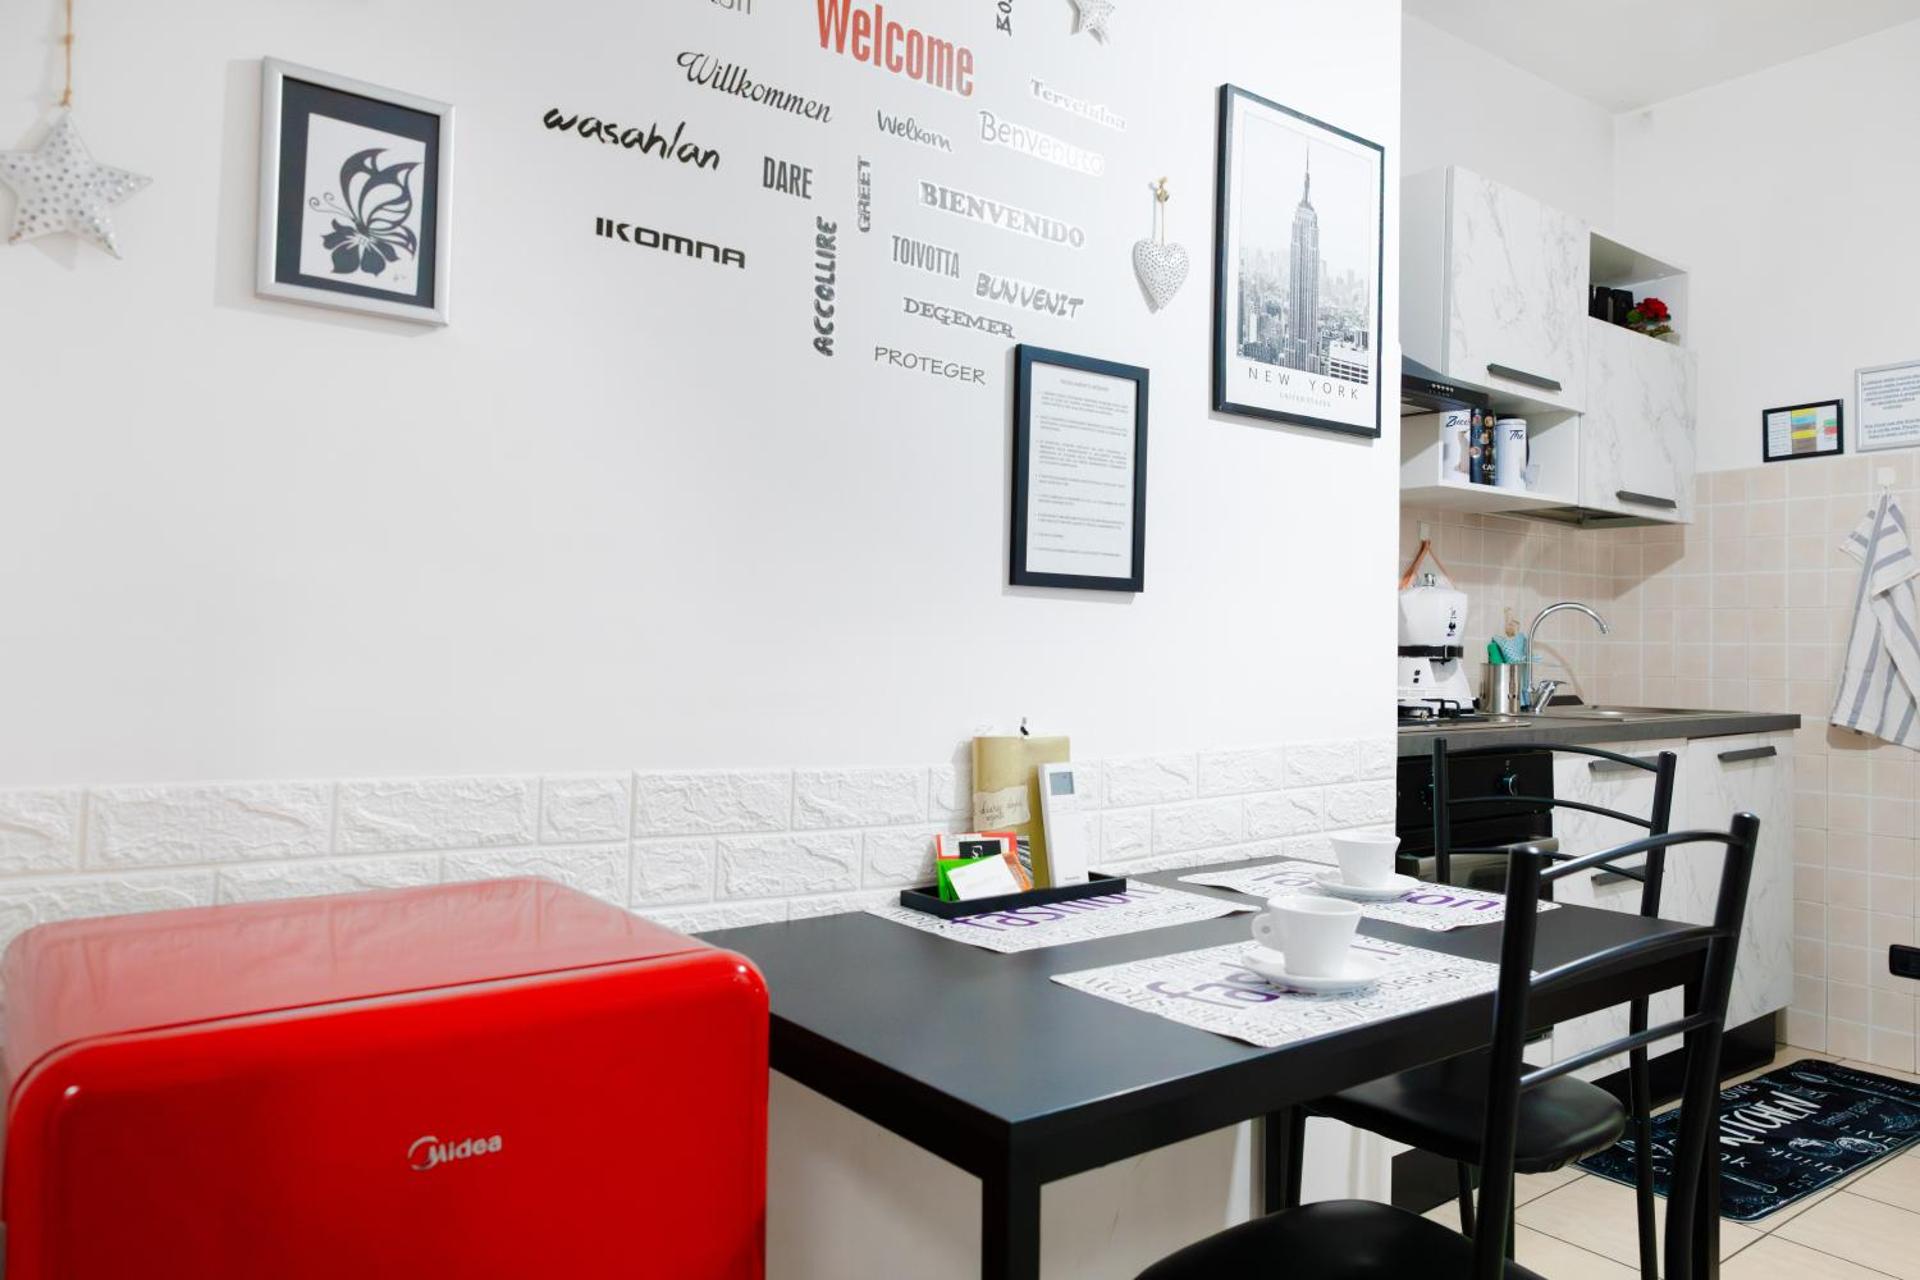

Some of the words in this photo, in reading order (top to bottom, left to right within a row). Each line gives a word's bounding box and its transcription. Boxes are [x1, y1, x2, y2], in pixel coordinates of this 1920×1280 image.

[816, 0, 974, 97] Welcome
[677, 51, 832, 123] Willkommen
[762, 156, 813, 199] DARE
[857, 155, 871, 232] GREET
[920, 181, 1085, 247] BIENVENIDO
[892, 235, 960, 278] TOIVOTTA
[812, 215, 838, 356] ACCOLLIRE
[903, 297, 1015, 338] DEGEMER
[874, 346, 986, 384] PROTEGER
[1248, 367, 1291, 386] NEW
[1309, 378, 1359, 400] YORK
[407, 1134, 503, 1171] Midea
